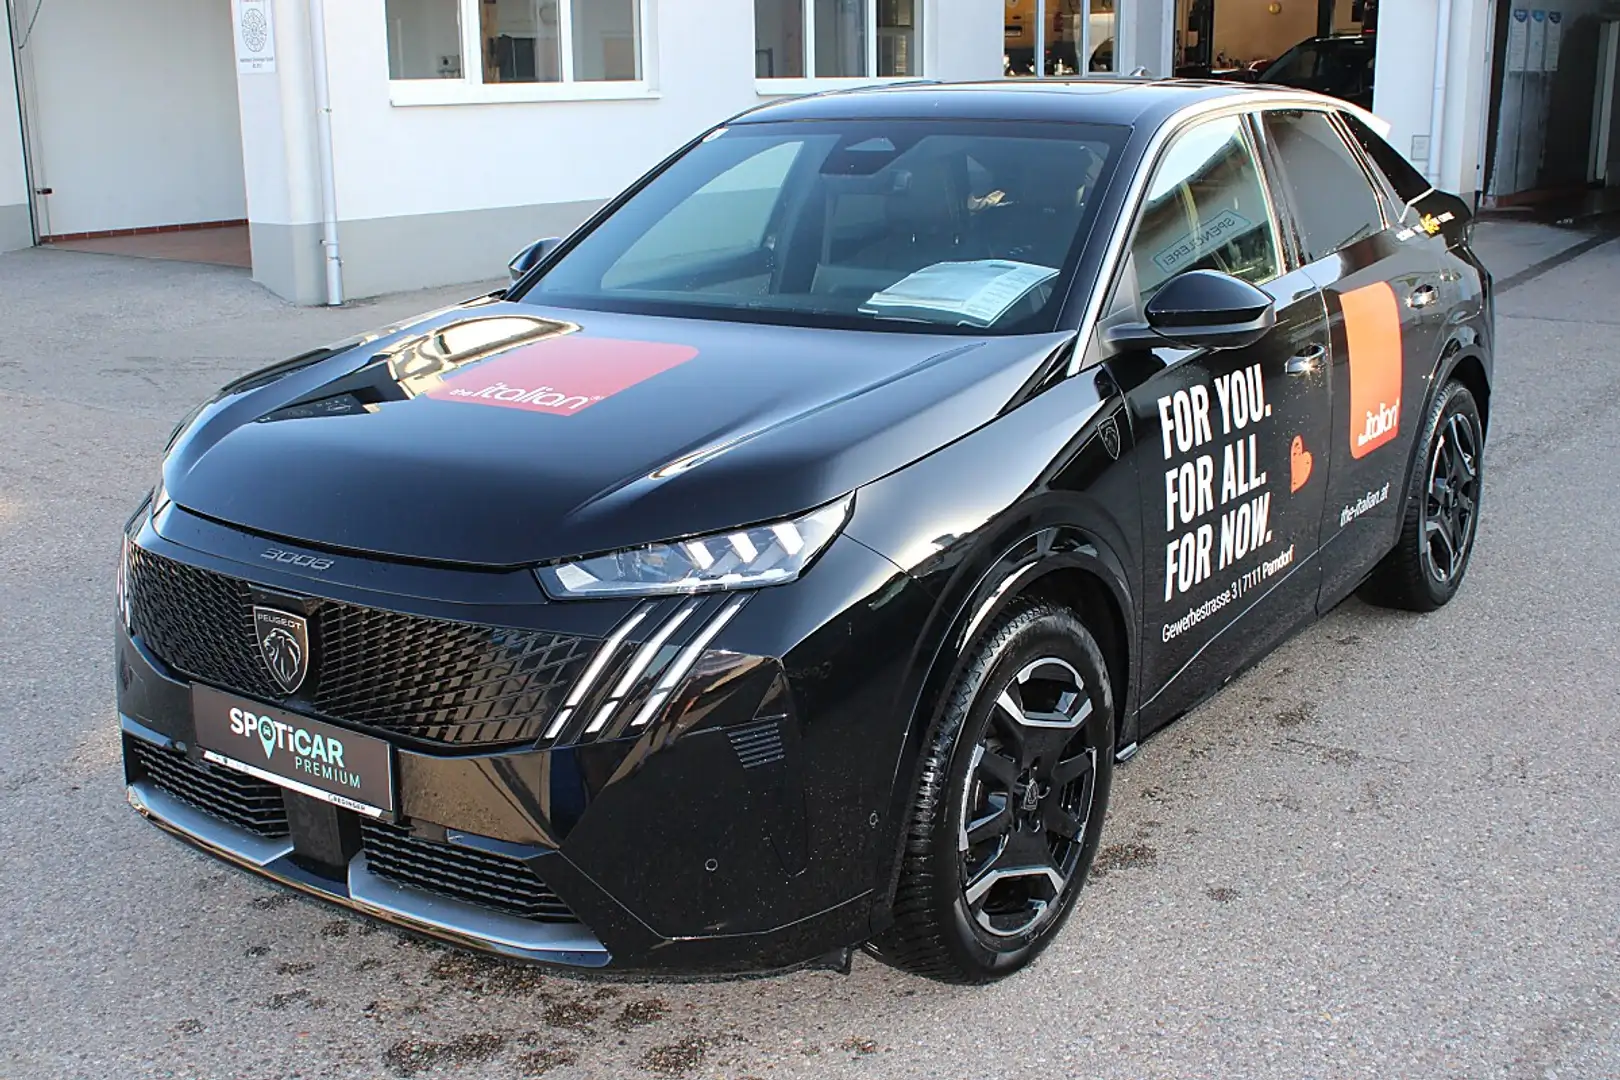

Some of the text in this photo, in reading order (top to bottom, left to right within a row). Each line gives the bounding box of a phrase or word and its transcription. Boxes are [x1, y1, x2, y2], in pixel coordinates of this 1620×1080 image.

[472, 382, 588, 409] italian
[1157, 363, 1272, 460] FOR YOU.
[1165, 433, 1266, 533] FOR ALL.
[260, 547, 335, 571] 3008
[1164, 491, 1272, 602] FOR NOW.
[257, 613, 302, 630] PEUGEOT
[1162, 589, 1231, 643] Gewerbestrasse
[1230, 581, 1238, 600] 3
[1242, 565, 1261, 593] 7111
[1262, 543, 1295, 579] Parndorf
[295, 756, 361, 789] PREMIUM
